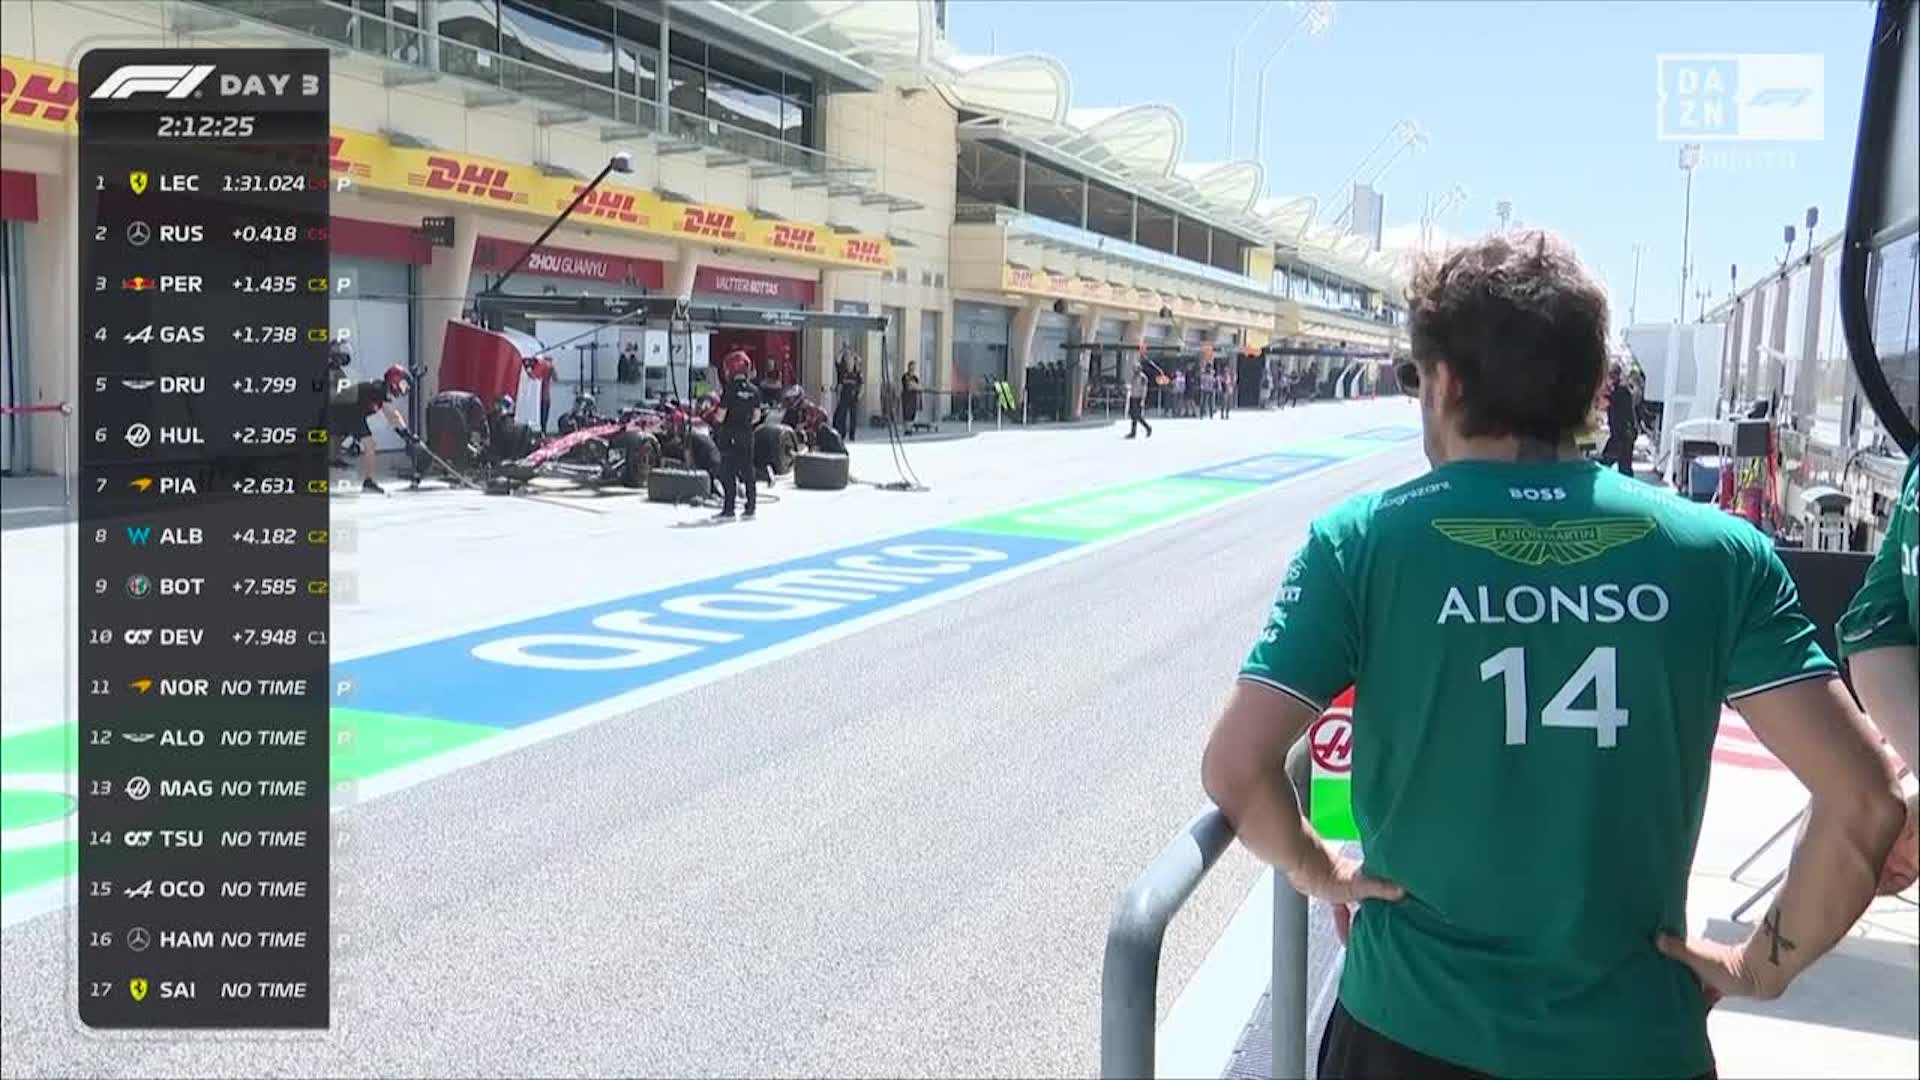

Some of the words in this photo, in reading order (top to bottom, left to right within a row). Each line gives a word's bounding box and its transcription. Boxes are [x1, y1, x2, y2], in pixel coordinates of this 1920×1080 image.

[426, 155, 513, 201] DHL
[566, 183, 639, 223] DHL
[683, 206, 737, 241] DHL
[773, 223, 817, 252] DHL
[529, 253, 561, 271] ZHOU
[561, 256, 607, 277] GUANYU
[846, 238, 886, 265] DHL
[1508, 485, 1567, 501] BOSS
[469, 542, 1009, 671] aramco
[1436, 582, 1671, 625] ALONSO
[1479, 645, 1629, 749] 14
